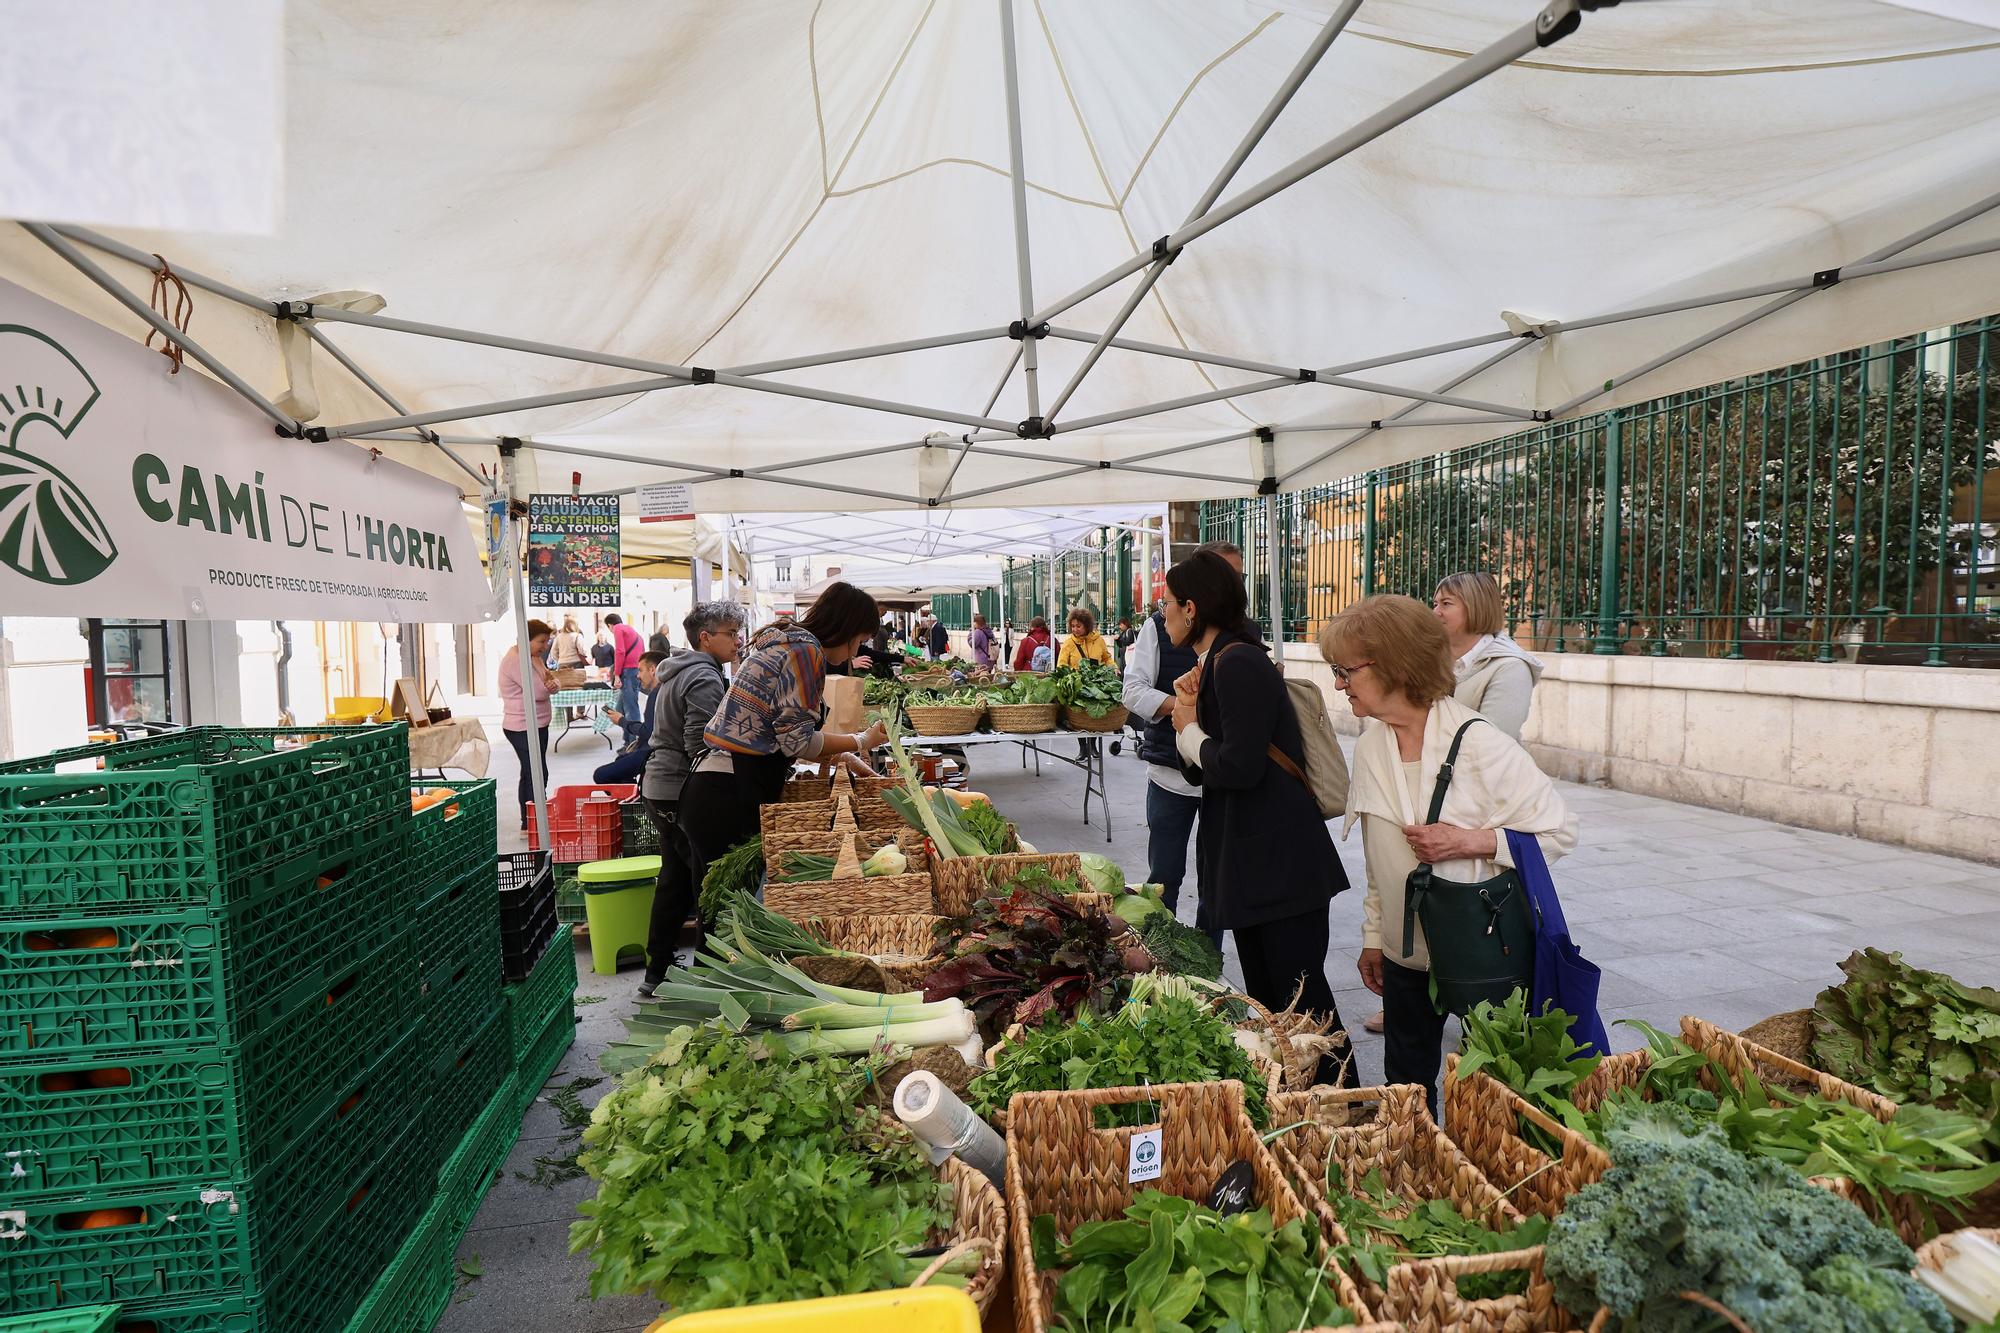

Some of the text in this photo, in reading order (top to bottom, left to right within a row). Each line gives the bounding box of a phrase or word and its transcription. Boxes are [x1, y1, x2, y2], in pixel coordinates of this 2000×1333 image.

[530, 495, 618, 506] ALIMENTACIÓ
[132, 453, 453, 573] CAMÍ DE L'HORTA
[530, 505, 618, 516] SALUDABLE
[530, 515, 619, 525] Y SOSTENIBLE
[530, 524, 619, 533] PER A TOTHOM
[208, 569, 274, 590] PRODUCTE
[275, 576, 308, 592] FRESC
[309, 580, 322, 593] DE
[322, 581, 373, 598] TEMPORADA
[530, 592, 620, 605] ES UN DRET
